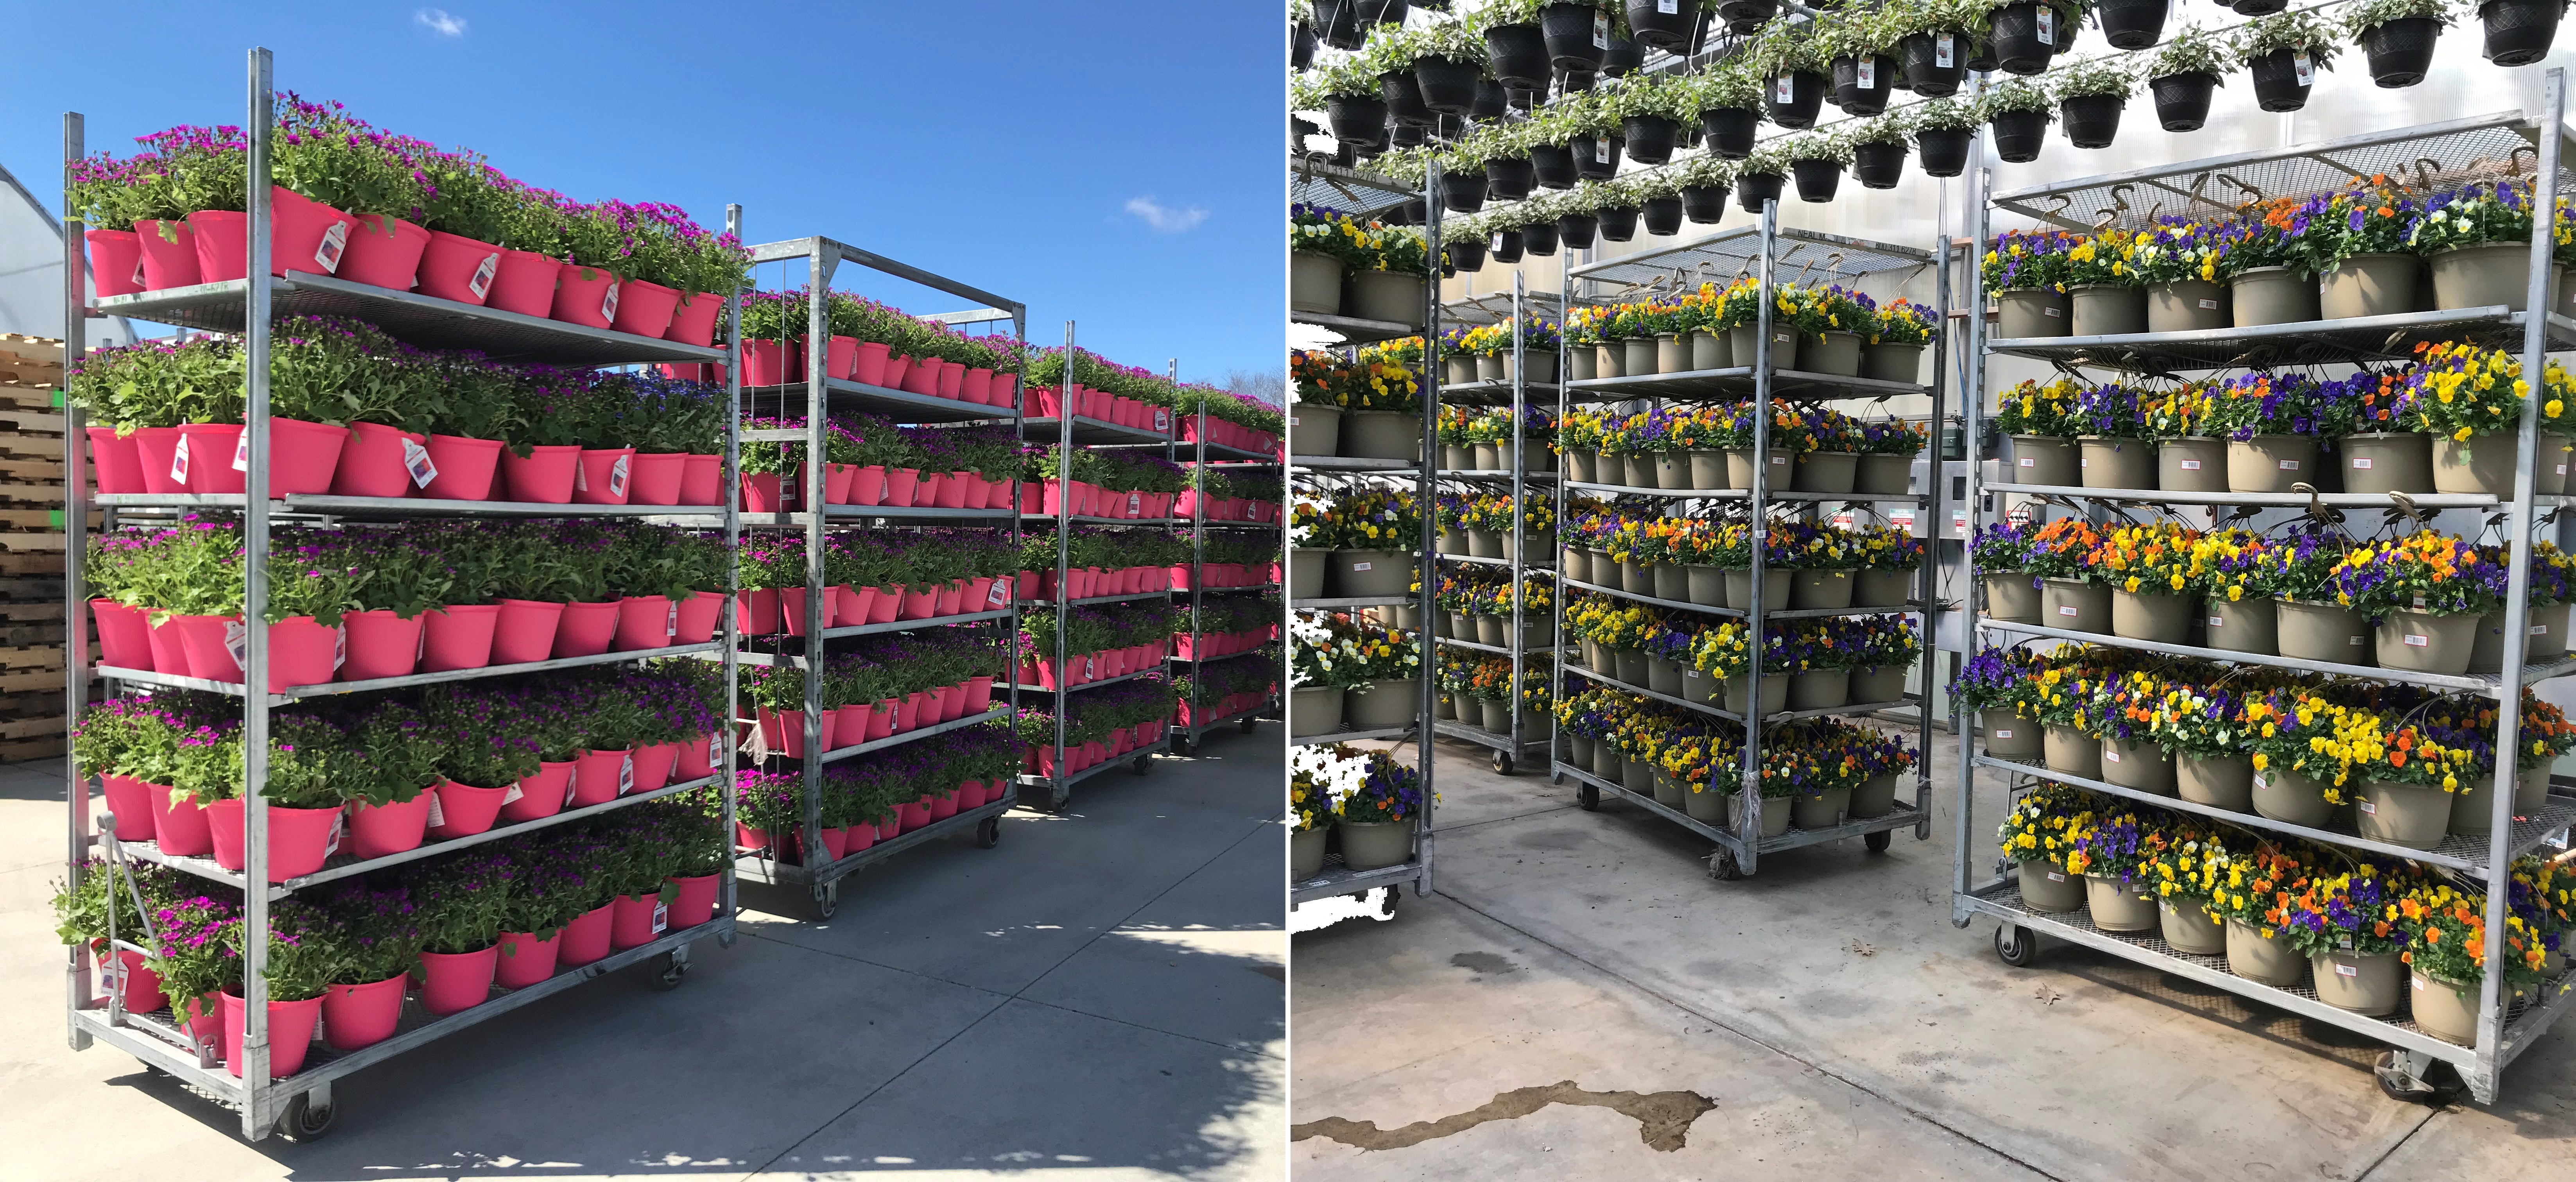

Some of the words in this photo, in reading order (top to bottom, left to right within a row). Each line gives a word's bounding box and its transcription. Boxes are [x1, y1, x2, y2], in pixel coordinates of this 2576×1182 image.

[1332, 165, 1349, 178] 311
[1353, 170, 1377, 183] 6278
[1798, 229, 1817, 240] NEAL
[1875, 242, 1887, 251] 800
[1888, 244, 1899, 253] 311
[1901, 246, 1916, 255] 6278
